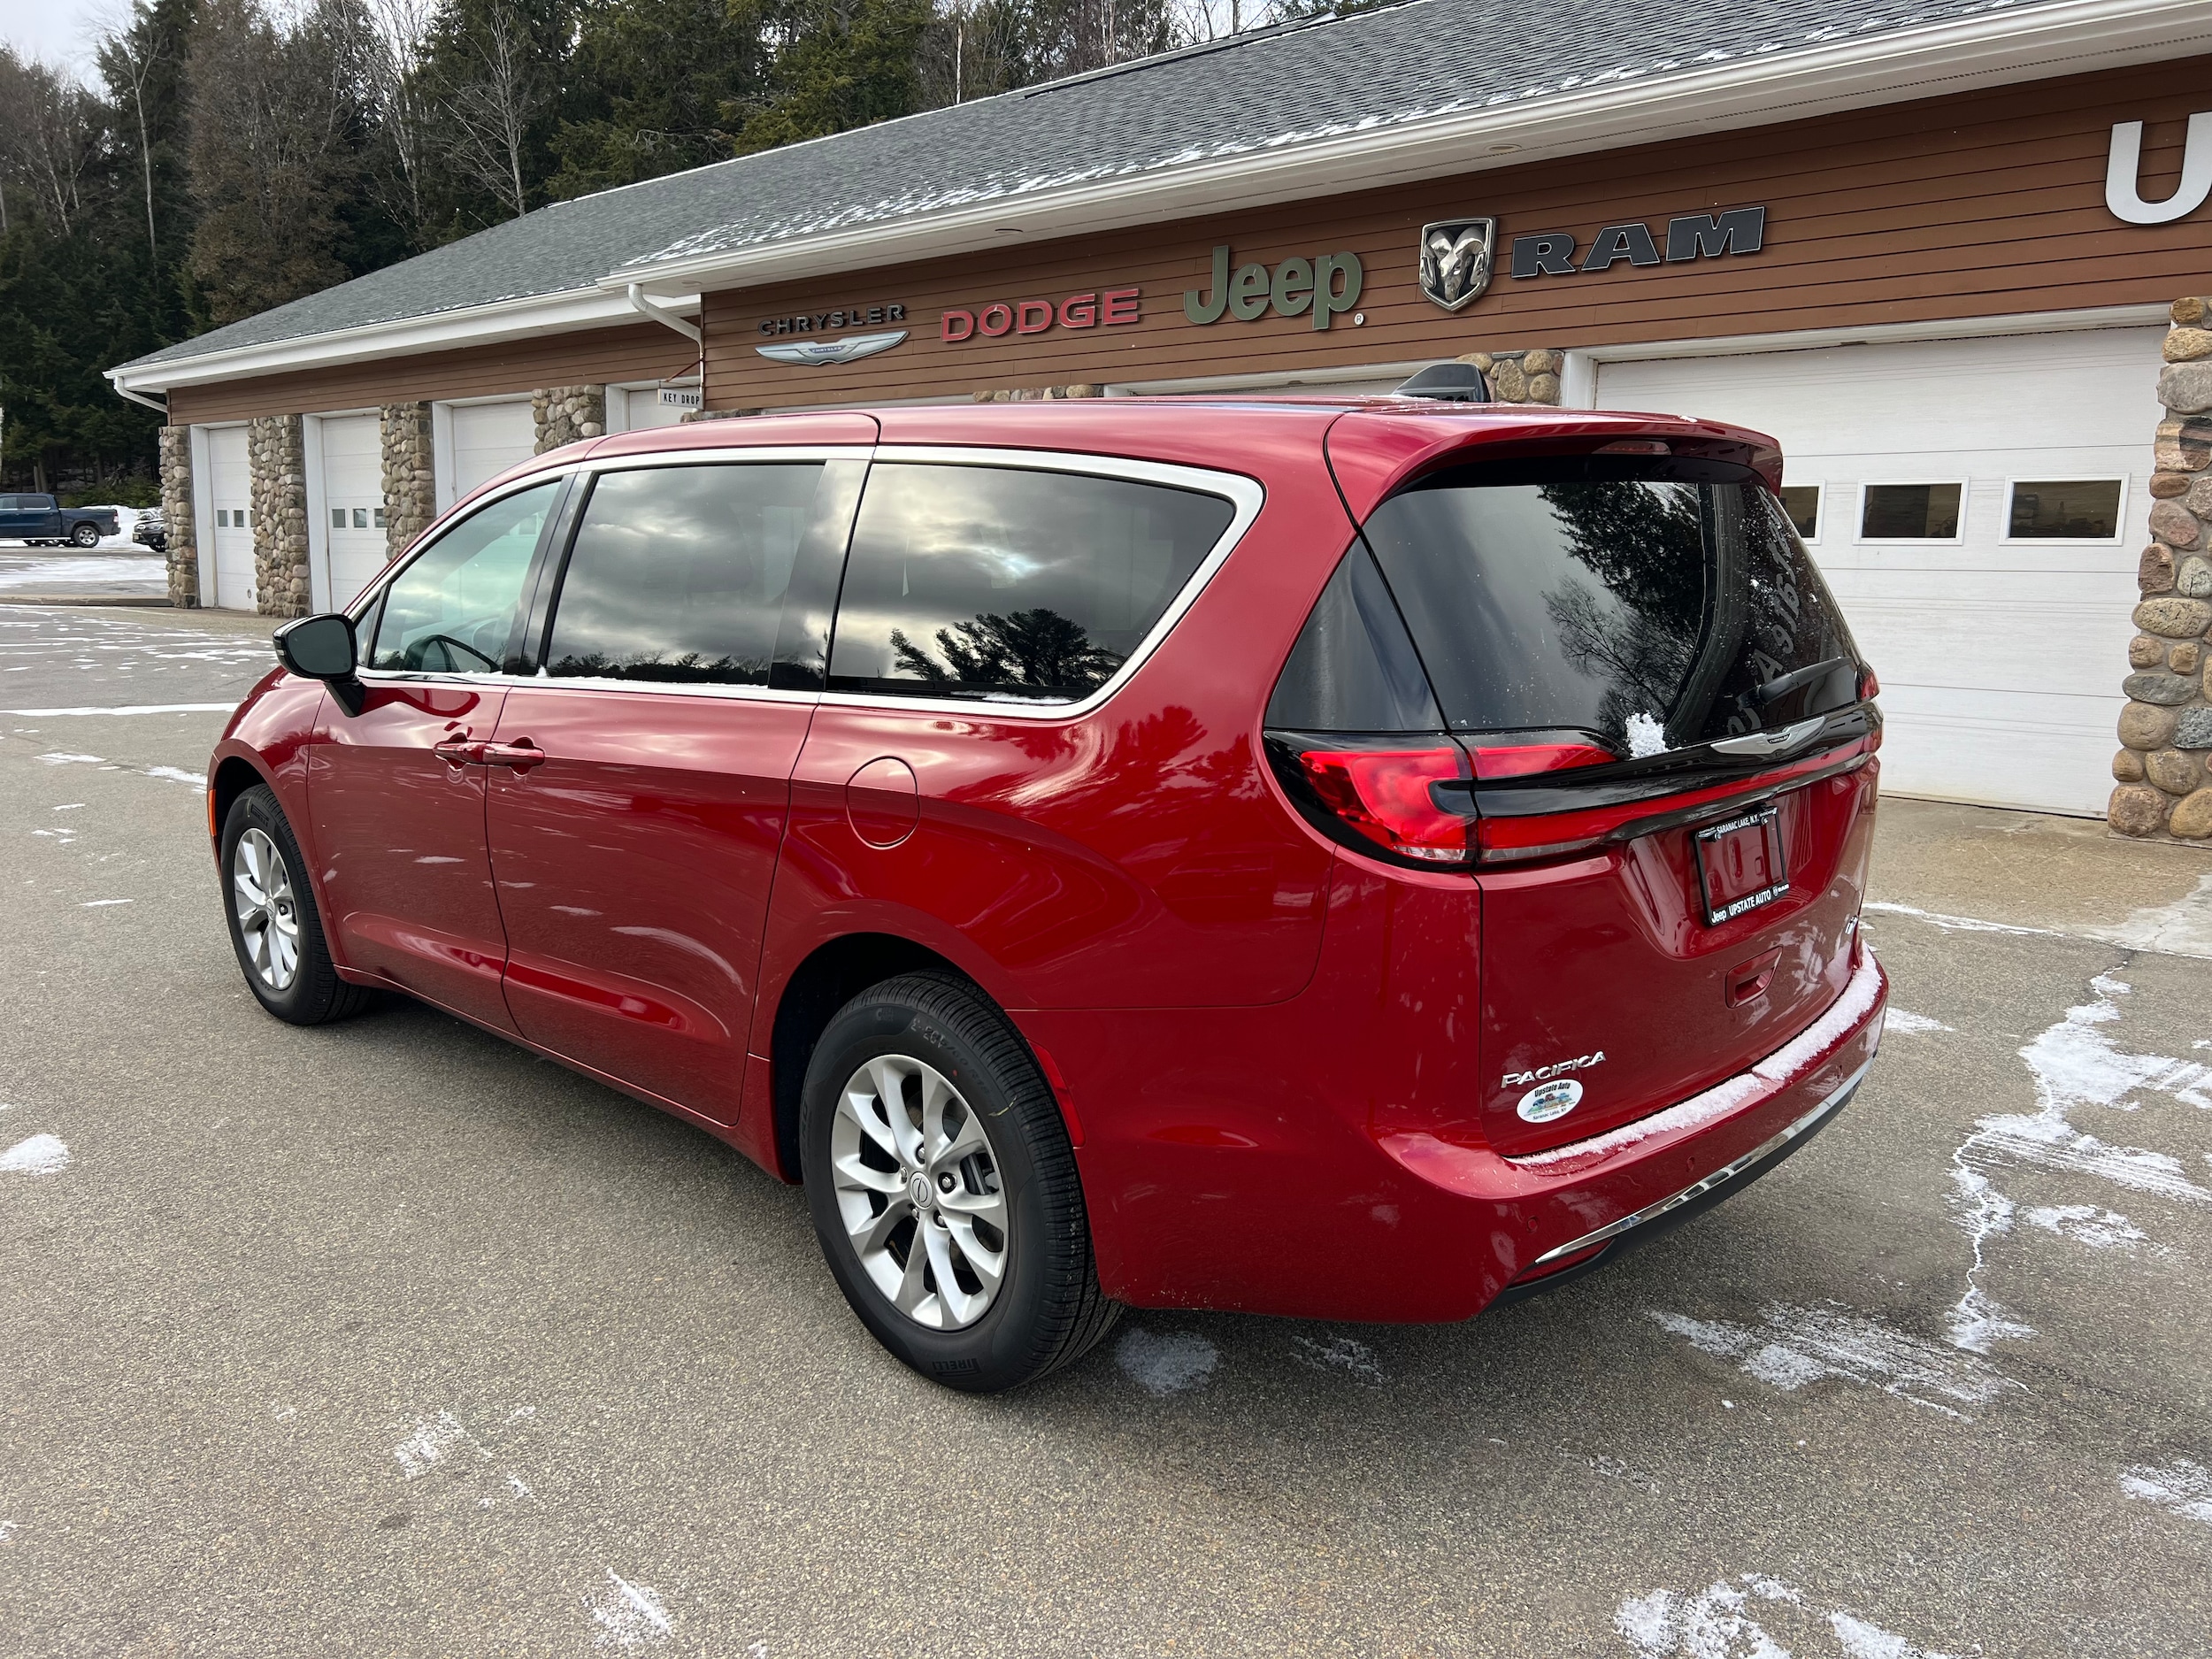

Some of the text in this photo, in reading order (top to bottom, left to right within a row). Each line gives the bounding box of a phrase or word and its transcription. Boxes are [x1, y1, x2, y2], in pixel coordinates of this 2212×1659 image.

[1509, 205, 1766, 279] RAM
[1183, 244, 1363, 330] Jeep
[757, 303, 905, 336] CHRYSLER
[940, 287, 1141, 342] DODGE
[664, 392, 700, 405] KEY DROP
[1717, 819, 1738, 834] SARANAC
[1711, 910, 1727, 923] Jeep
[1728, 895, 1755, 917] UPSTATE
[1755, 889, 1771, 905] AUTO
[1501, 1050, 1606, 1088] PACIFICA
[1534, 1084, 1558, 1097] Upstate
